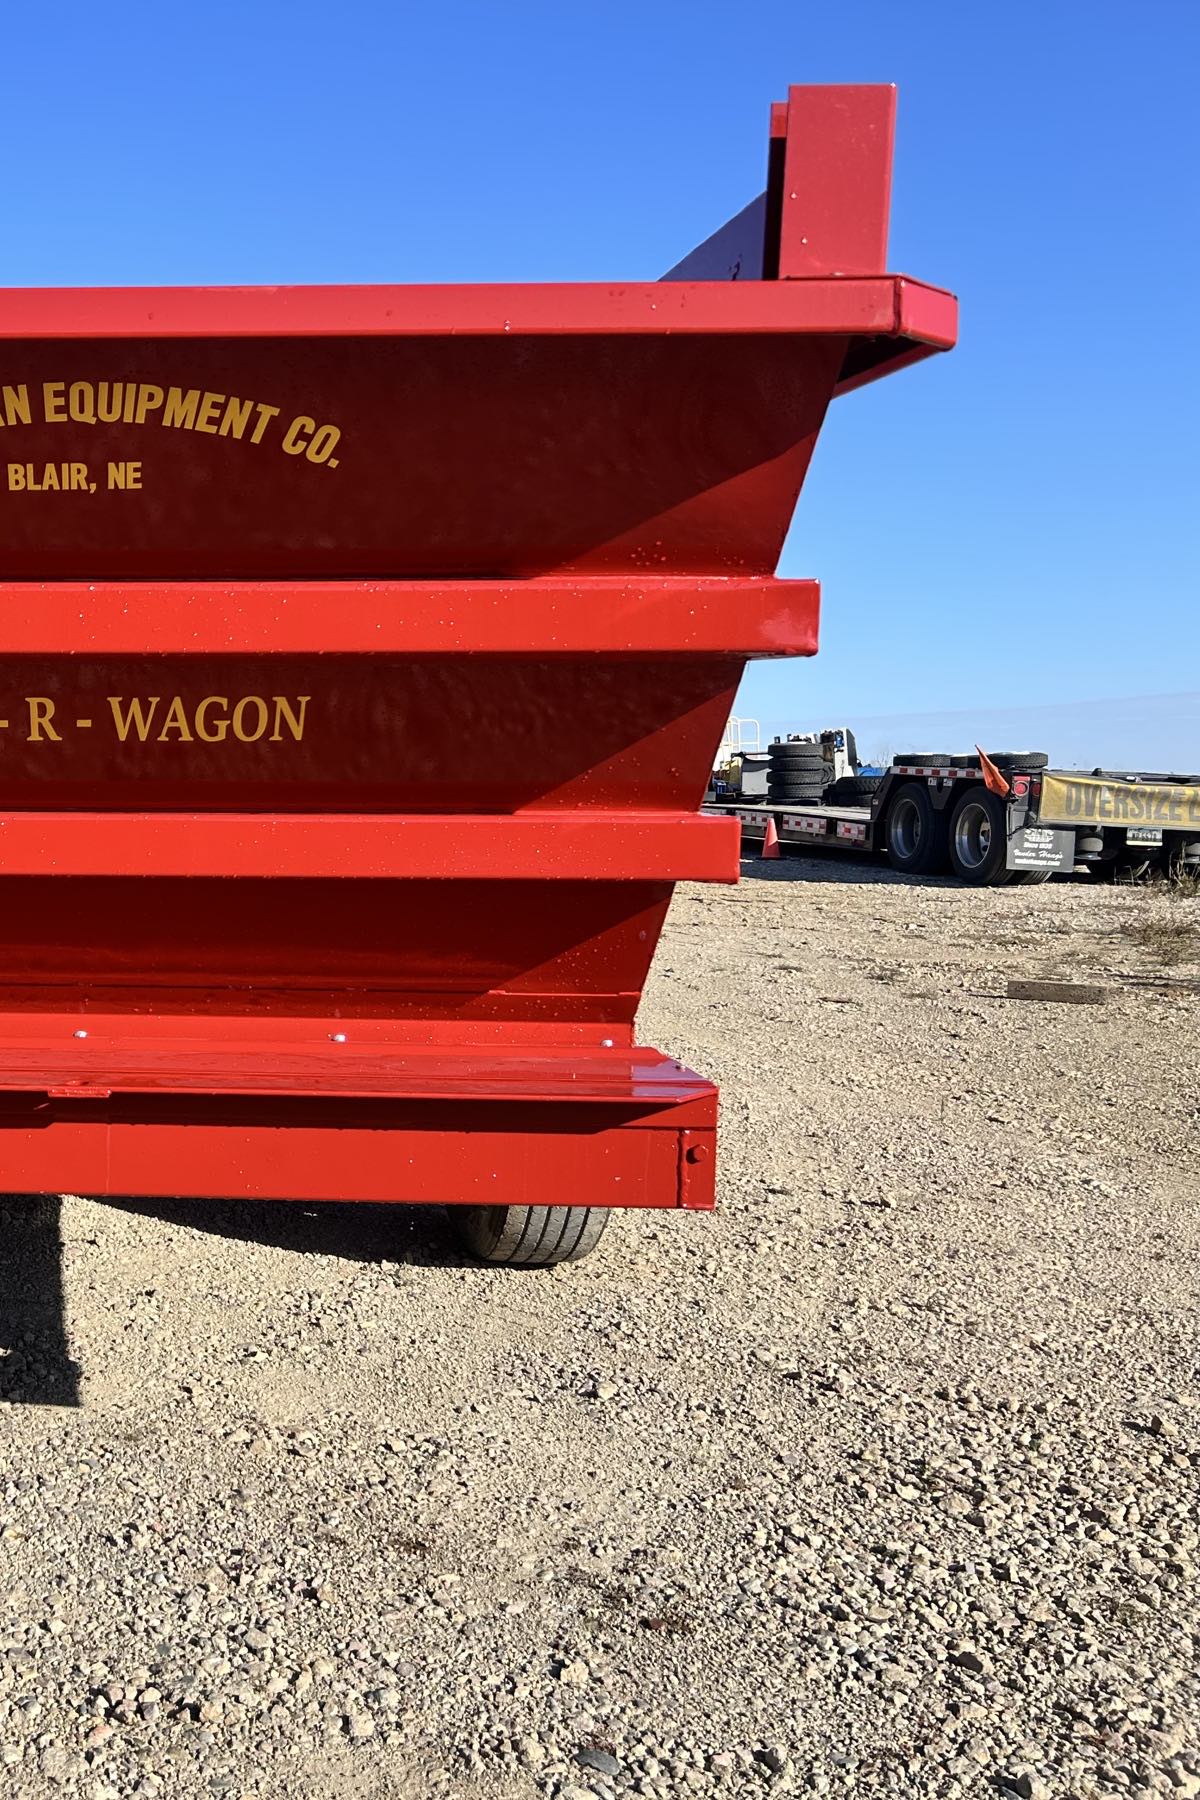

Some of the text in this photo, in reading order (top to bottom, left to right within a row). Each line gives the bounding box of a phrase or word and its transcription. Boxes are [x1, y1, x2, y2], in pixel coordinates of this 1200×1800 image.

[43, 381, 281, 445] EQUIPMENT
[282, 415, 341, 469] CO.
[7, 461, 143, 494] BLAIR, NE
[25, 697, 63, 741] R
[106, 695, 311, 742] WAGON
[1065, 783, 1183, 821] OVERSIZE
